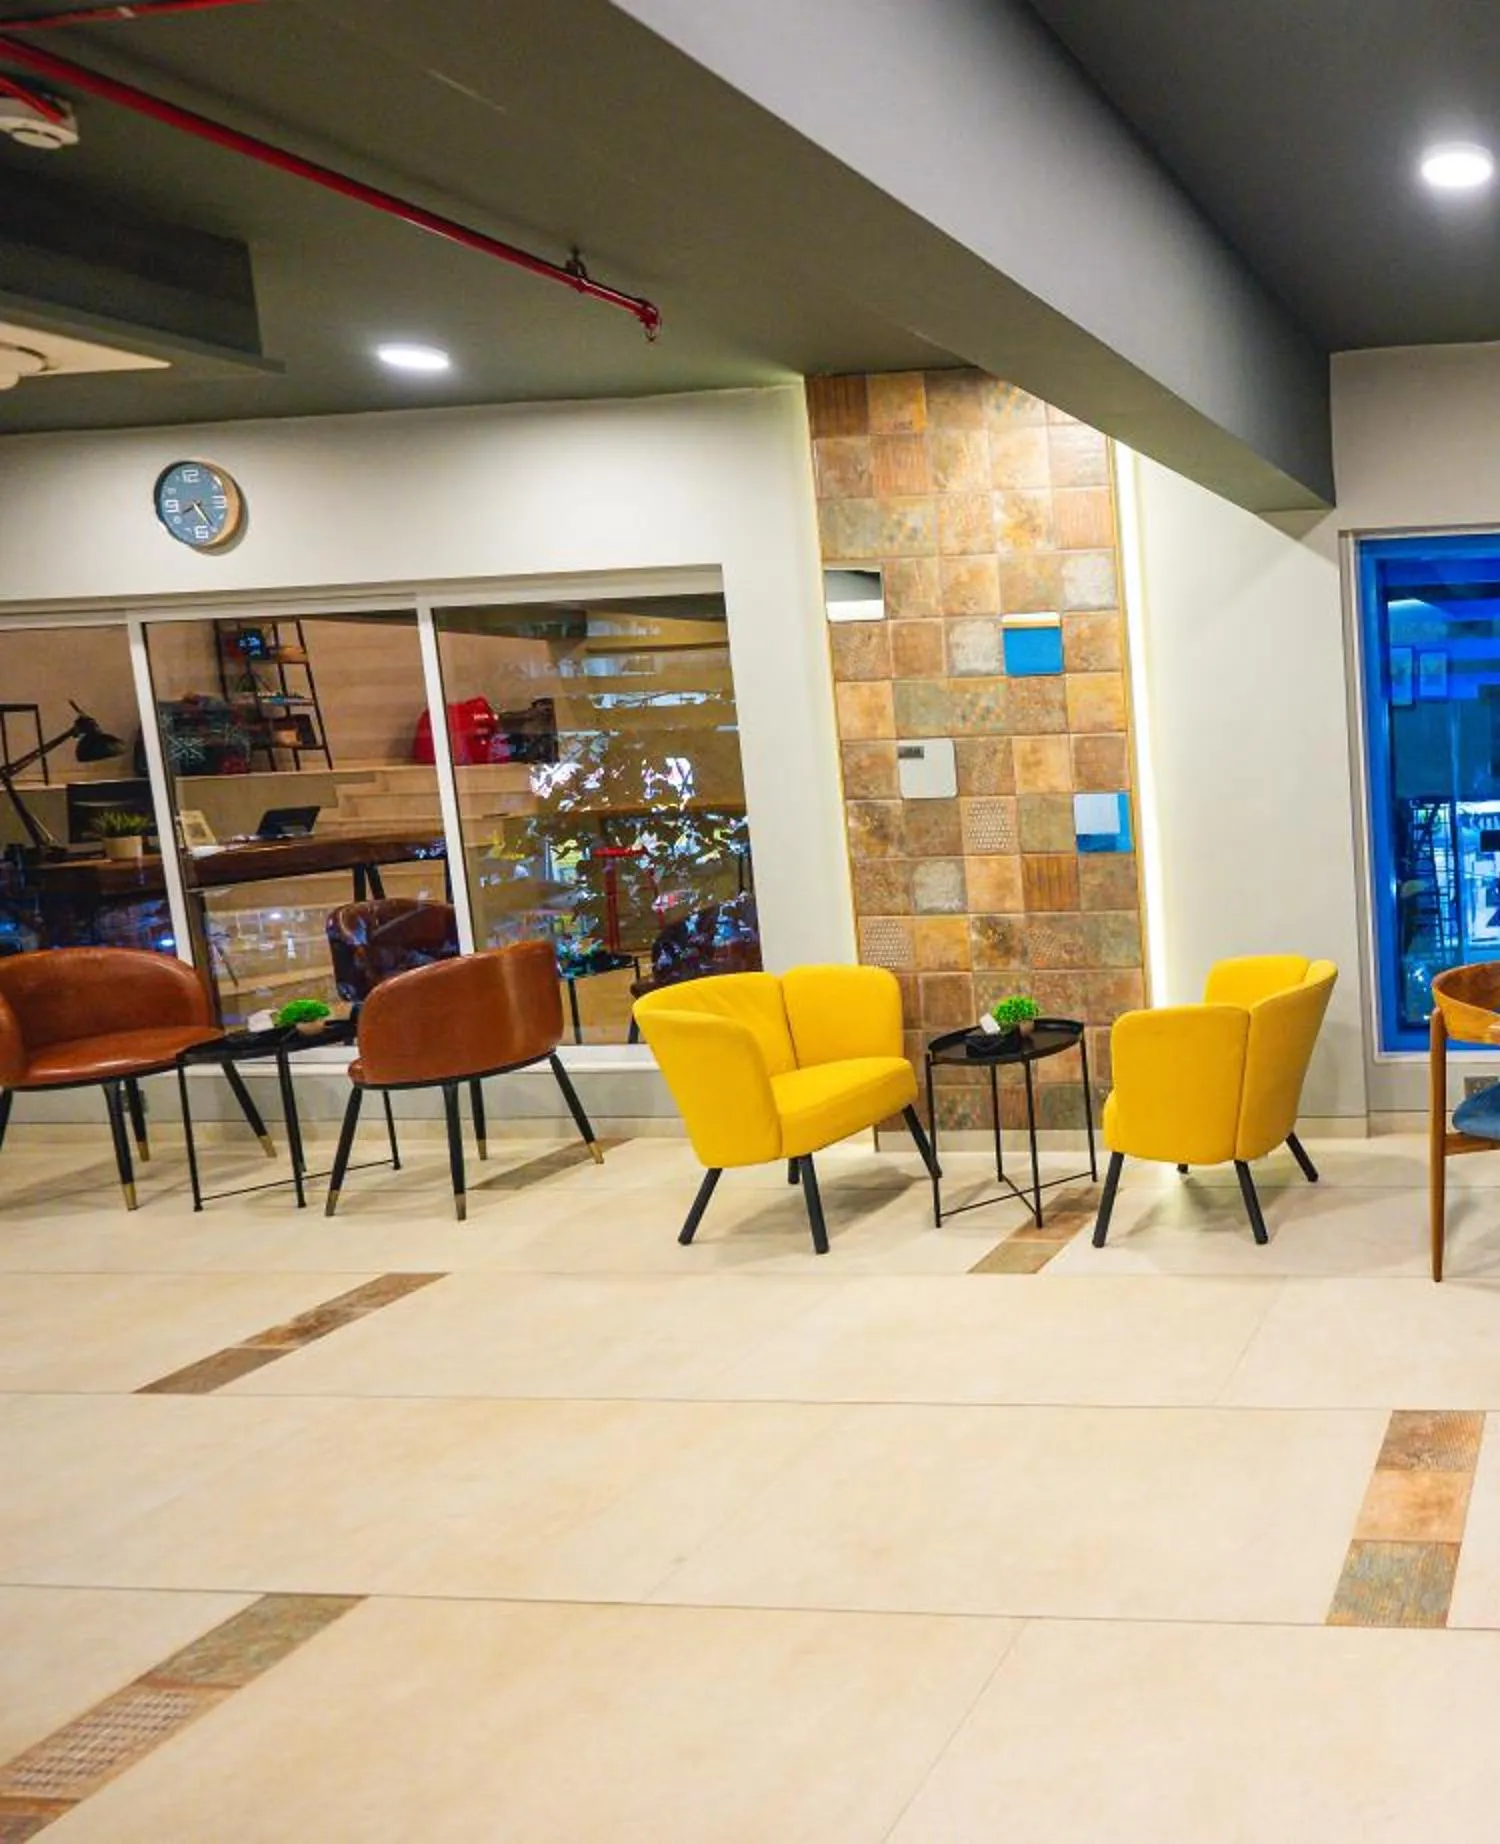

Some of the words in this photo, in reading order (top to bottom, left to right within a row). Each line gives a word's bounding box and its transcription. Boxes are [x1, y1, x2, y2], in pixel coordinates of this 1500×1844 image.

[182, 469, 199, 483] 12
[165, 499, 179, 513] 9
[212, 495, 226, 509] 3
[195, 525, 209, 539] 6
